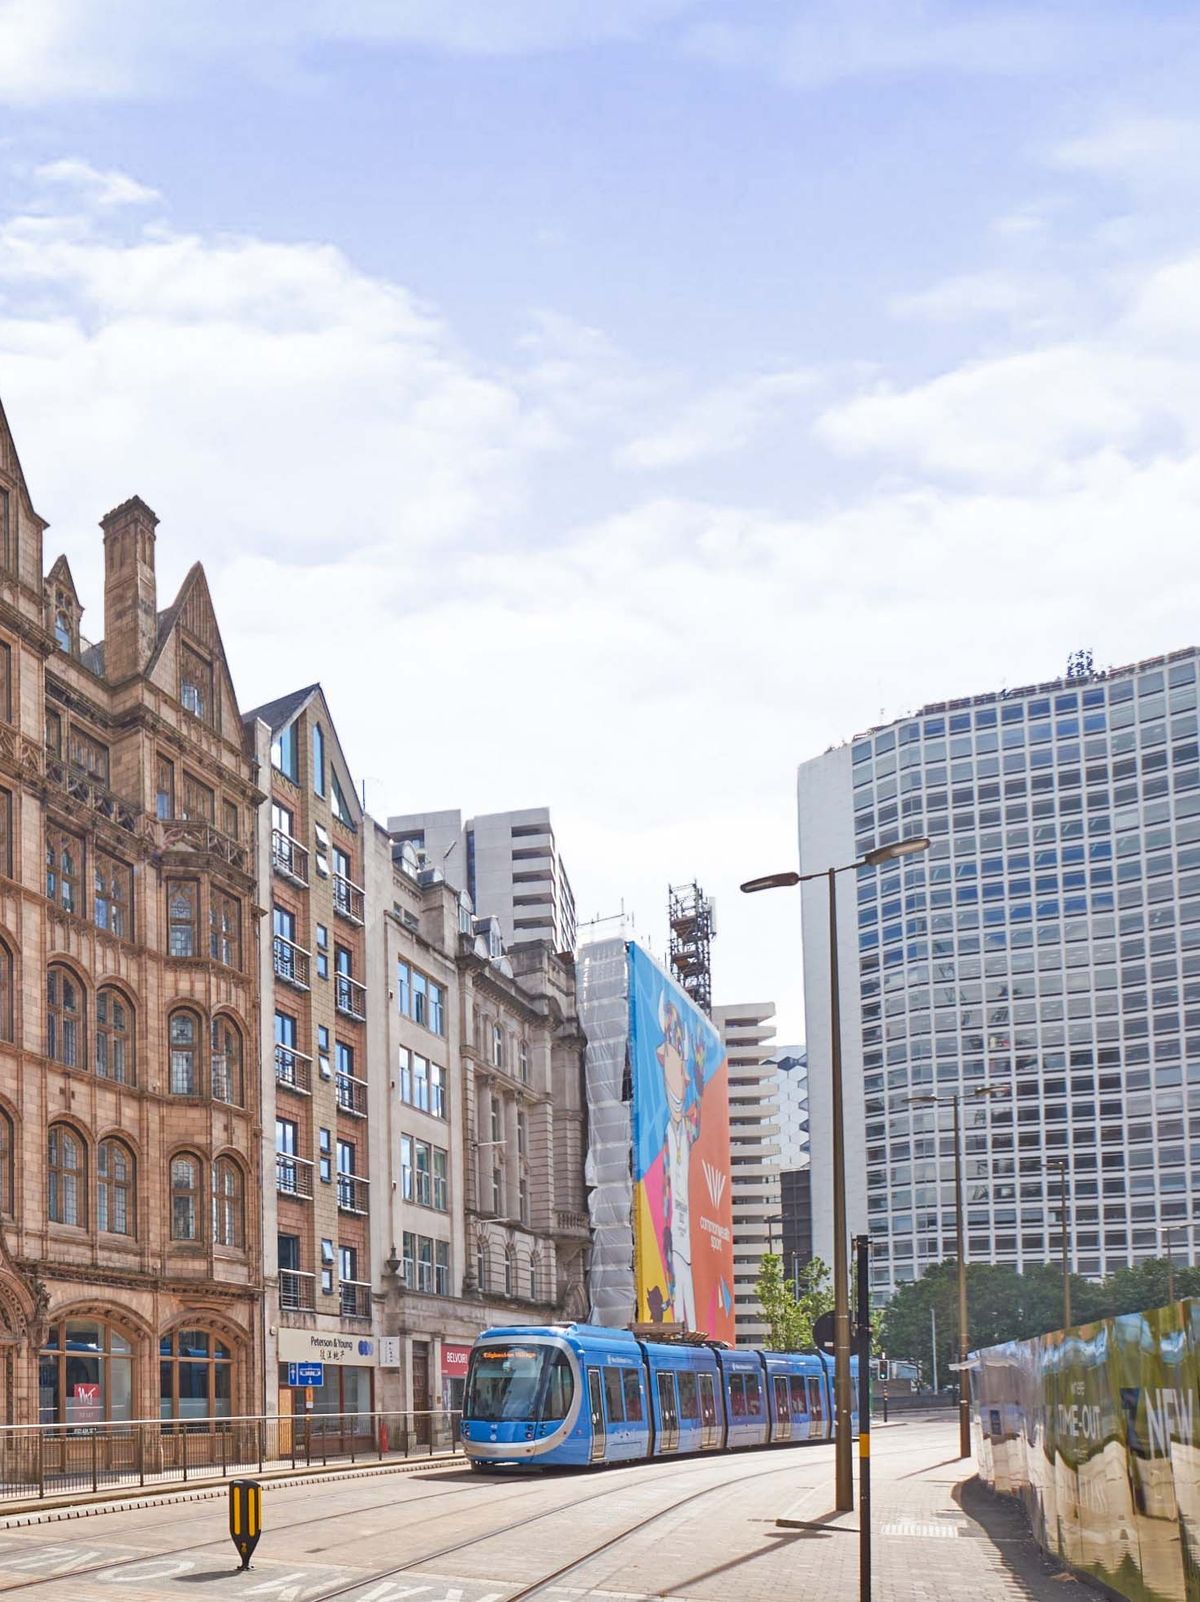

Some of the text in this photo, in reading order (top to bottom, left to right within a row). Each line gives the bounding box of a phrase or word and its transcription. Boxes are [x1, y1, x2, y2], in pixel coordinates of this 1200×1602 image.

[310, 1335, 333, 1348] Peterson
[338, 1339, 353, 1351] Young
[1058, 1404, 1101, 1441] TIME-OUT
